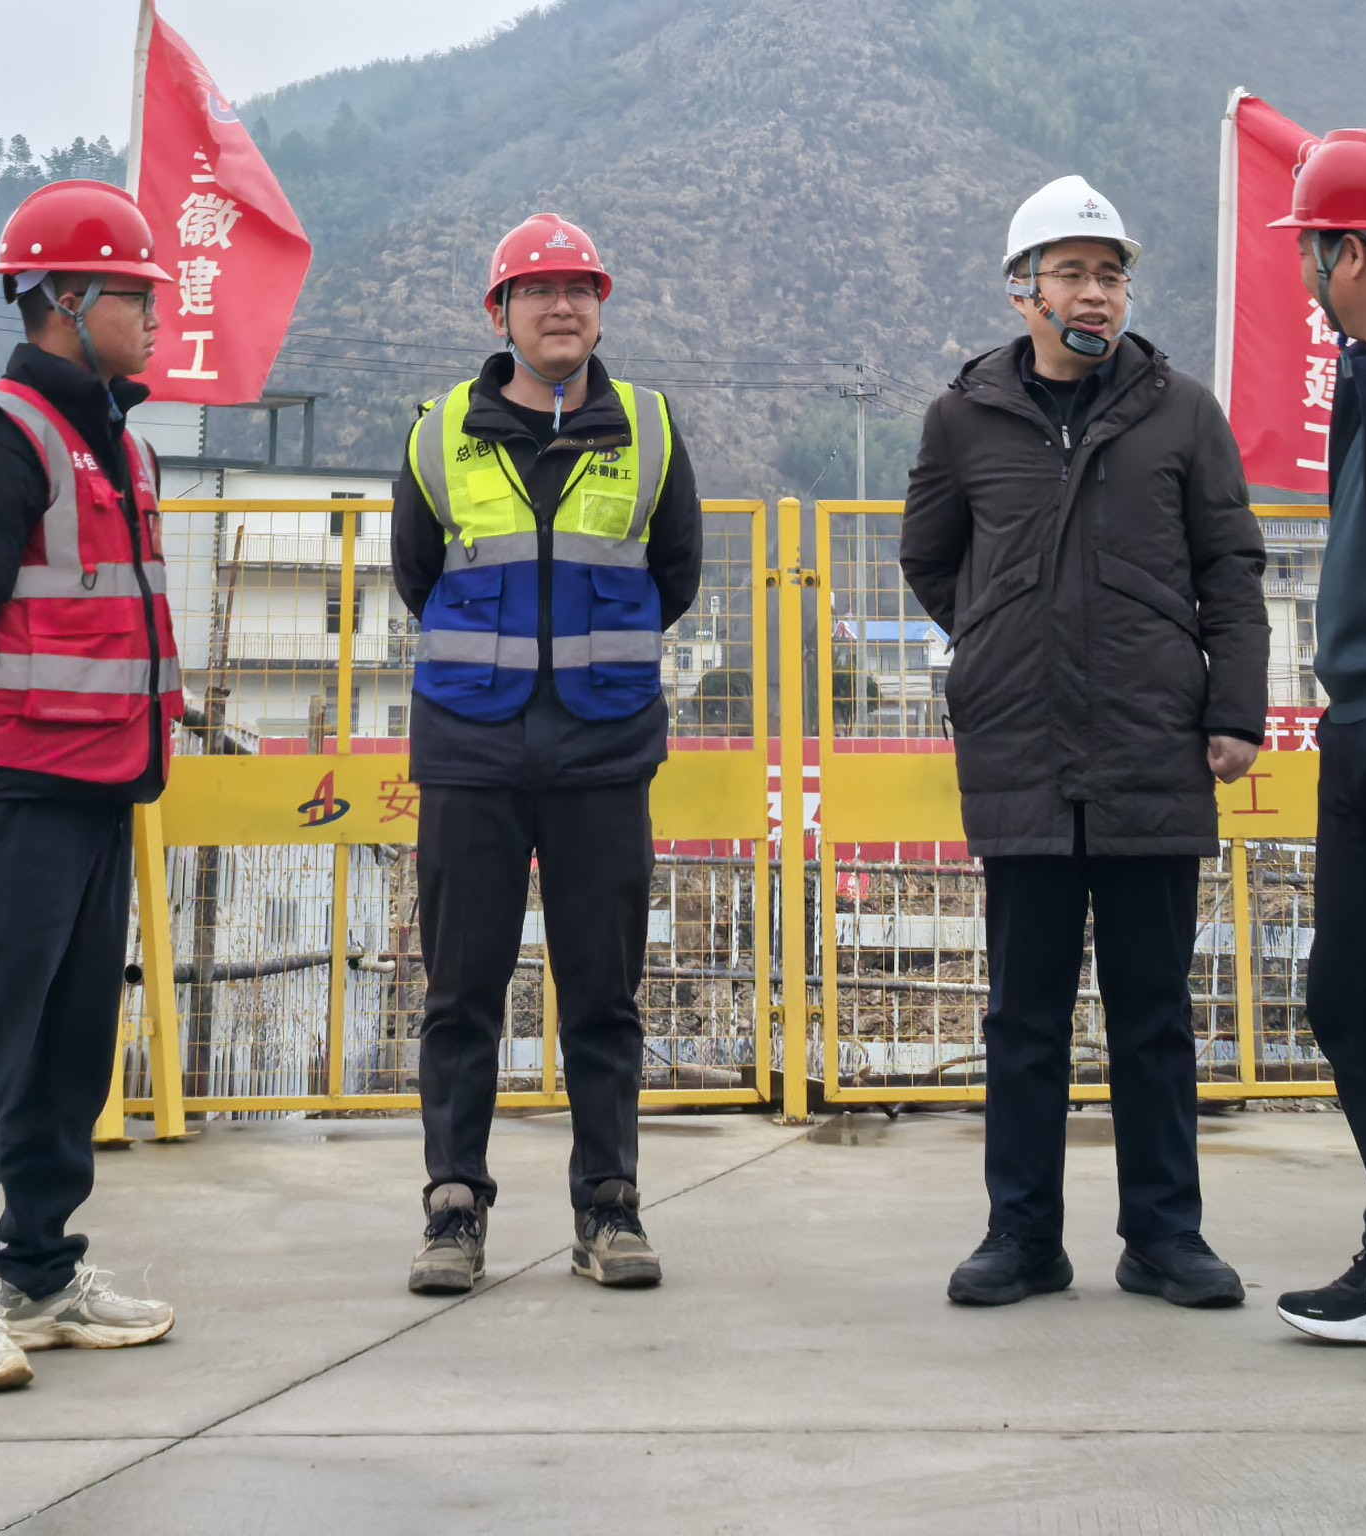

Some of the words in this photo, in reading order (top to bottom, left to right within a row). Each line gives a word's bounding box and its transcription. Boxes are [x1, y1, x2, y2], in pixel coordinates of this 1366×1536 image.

[456, 440, 491, 462] 总包
[585, 464, 632, 480] 安徽建工
